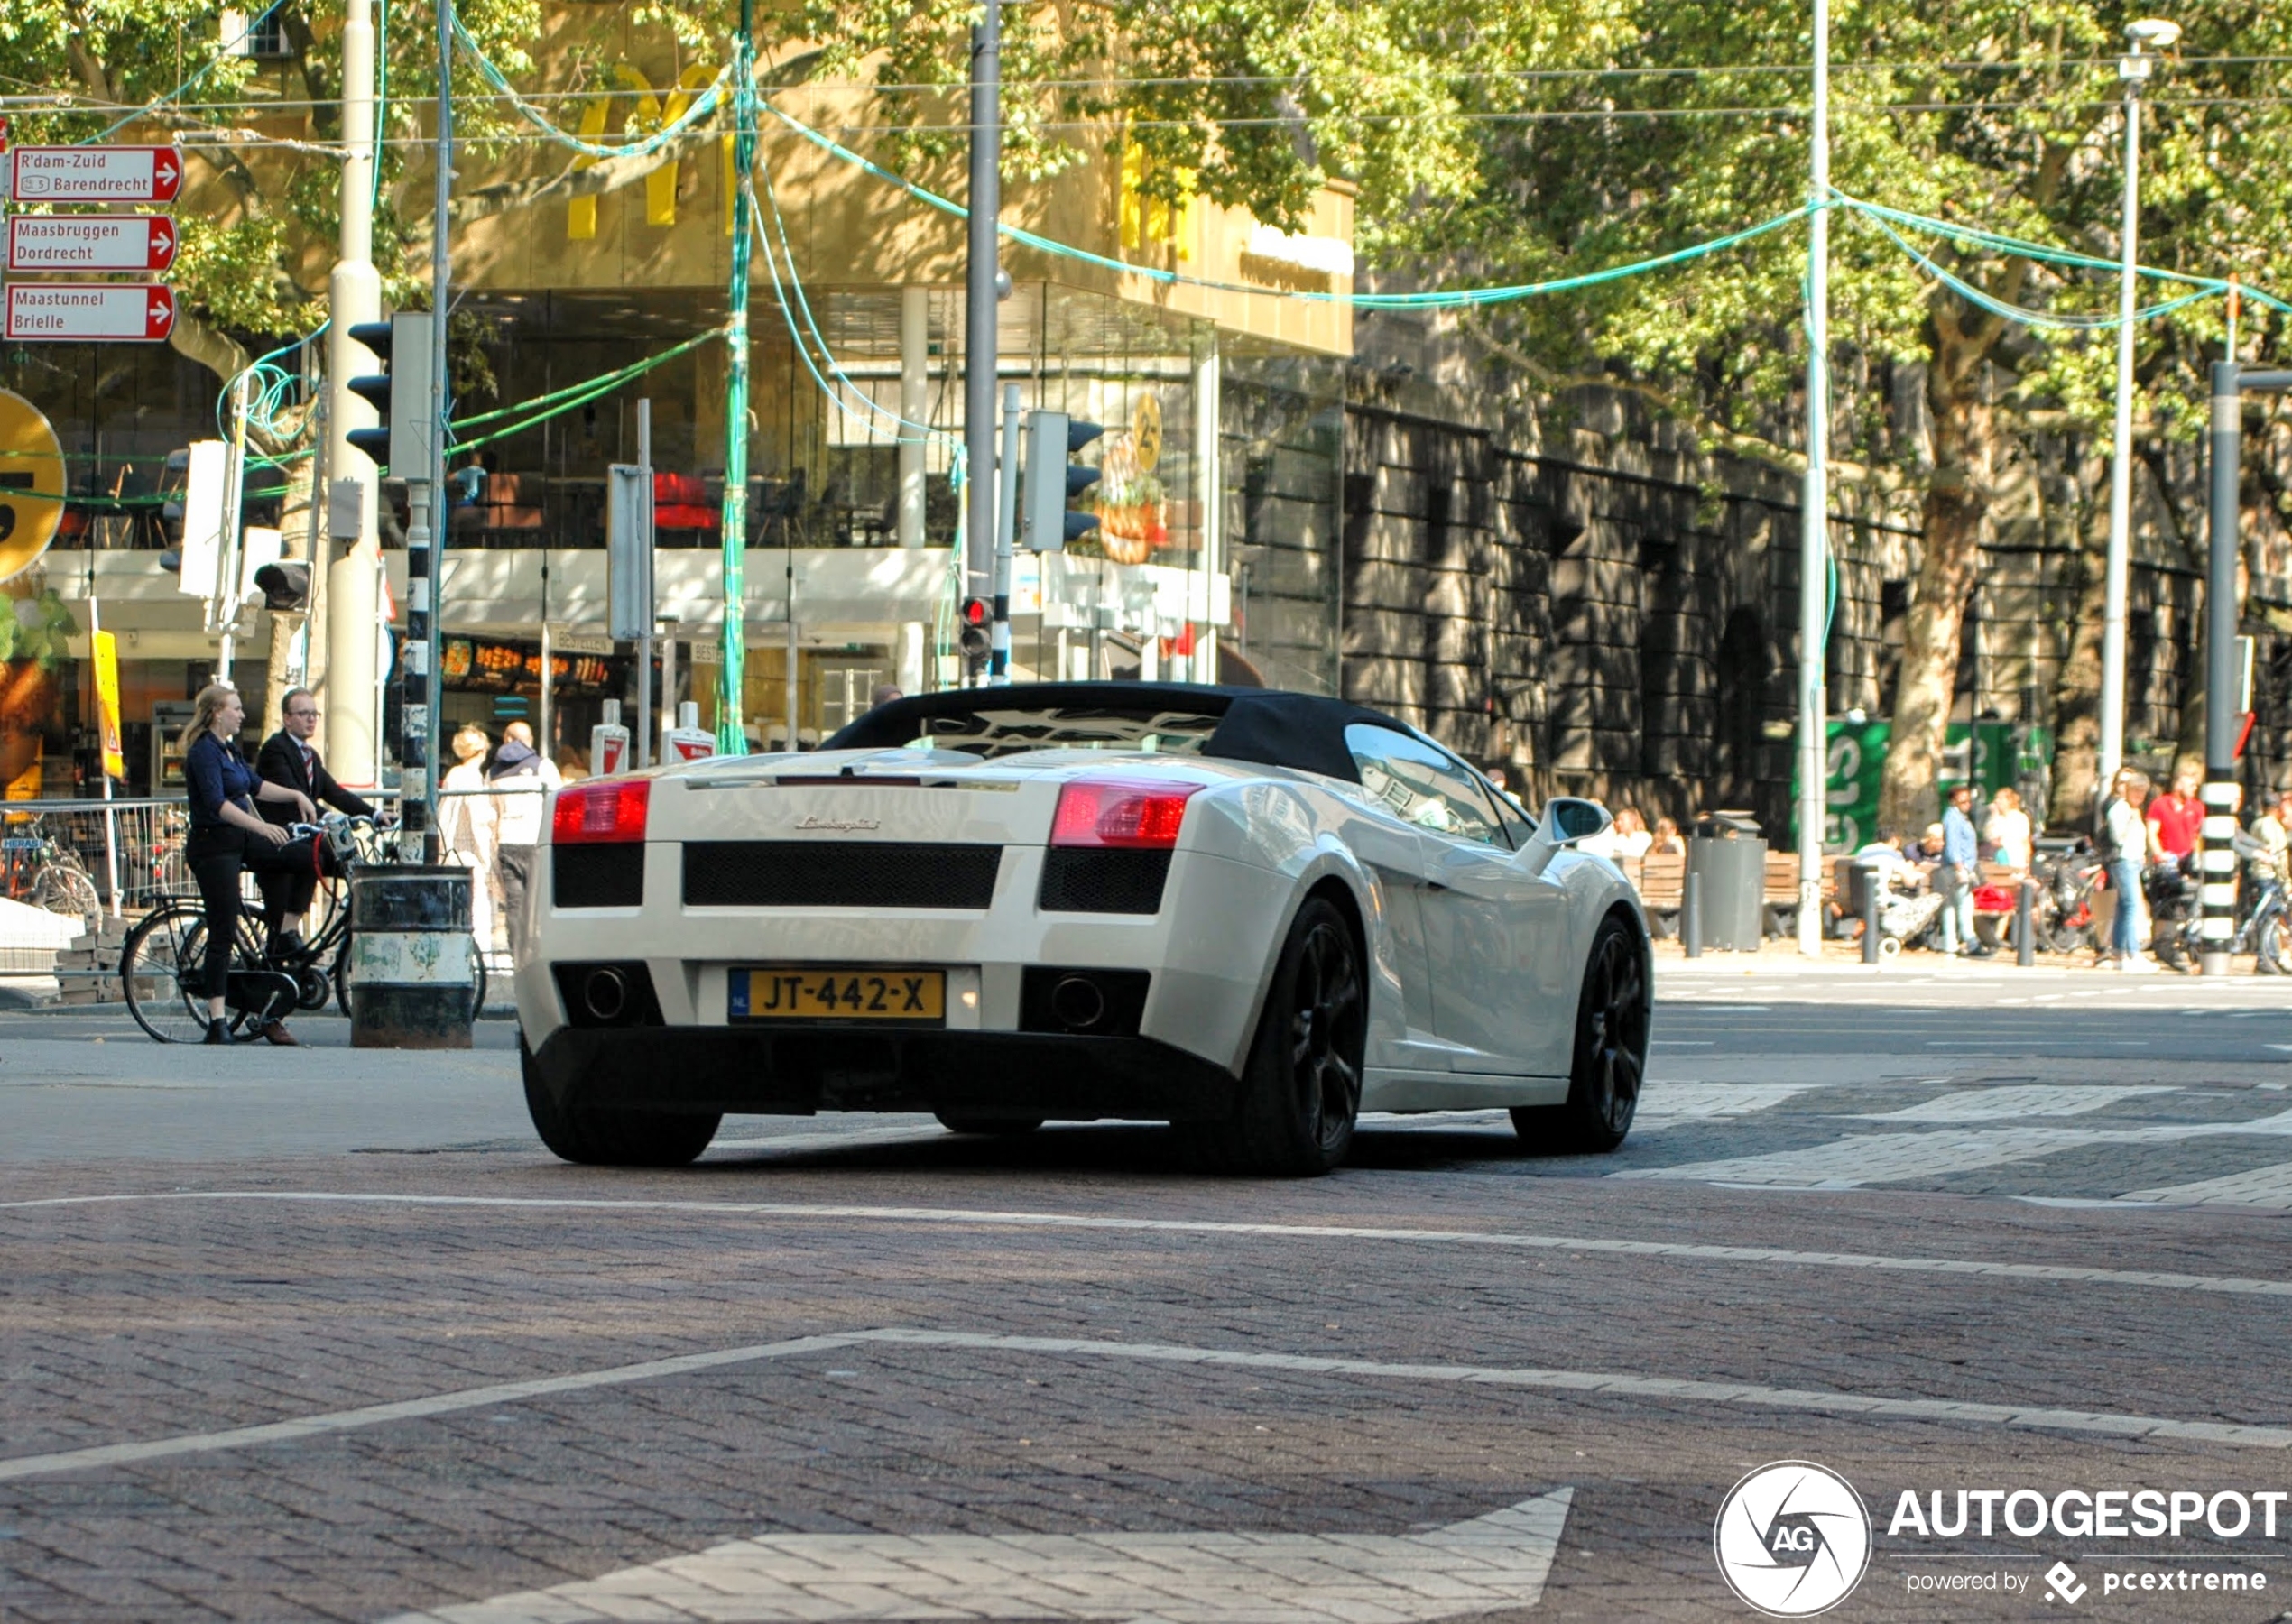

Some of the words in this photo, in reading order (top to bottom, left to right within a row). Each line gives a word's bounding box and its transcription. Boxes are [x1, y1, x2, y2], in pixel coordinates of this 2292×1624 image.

[21, 154, 106, 168] R'dam-Zuid
[54, 178, 148, 191] Barendrecht
[18, 223, 119, 241] Maasbruggen
[17, 245, 93, 260] Dordrecht
[15, 291, 104, 306] Maastunnel
[14, 315, 64, 328] Brielle
[763, 976, 924, 1012] JT-442-X
